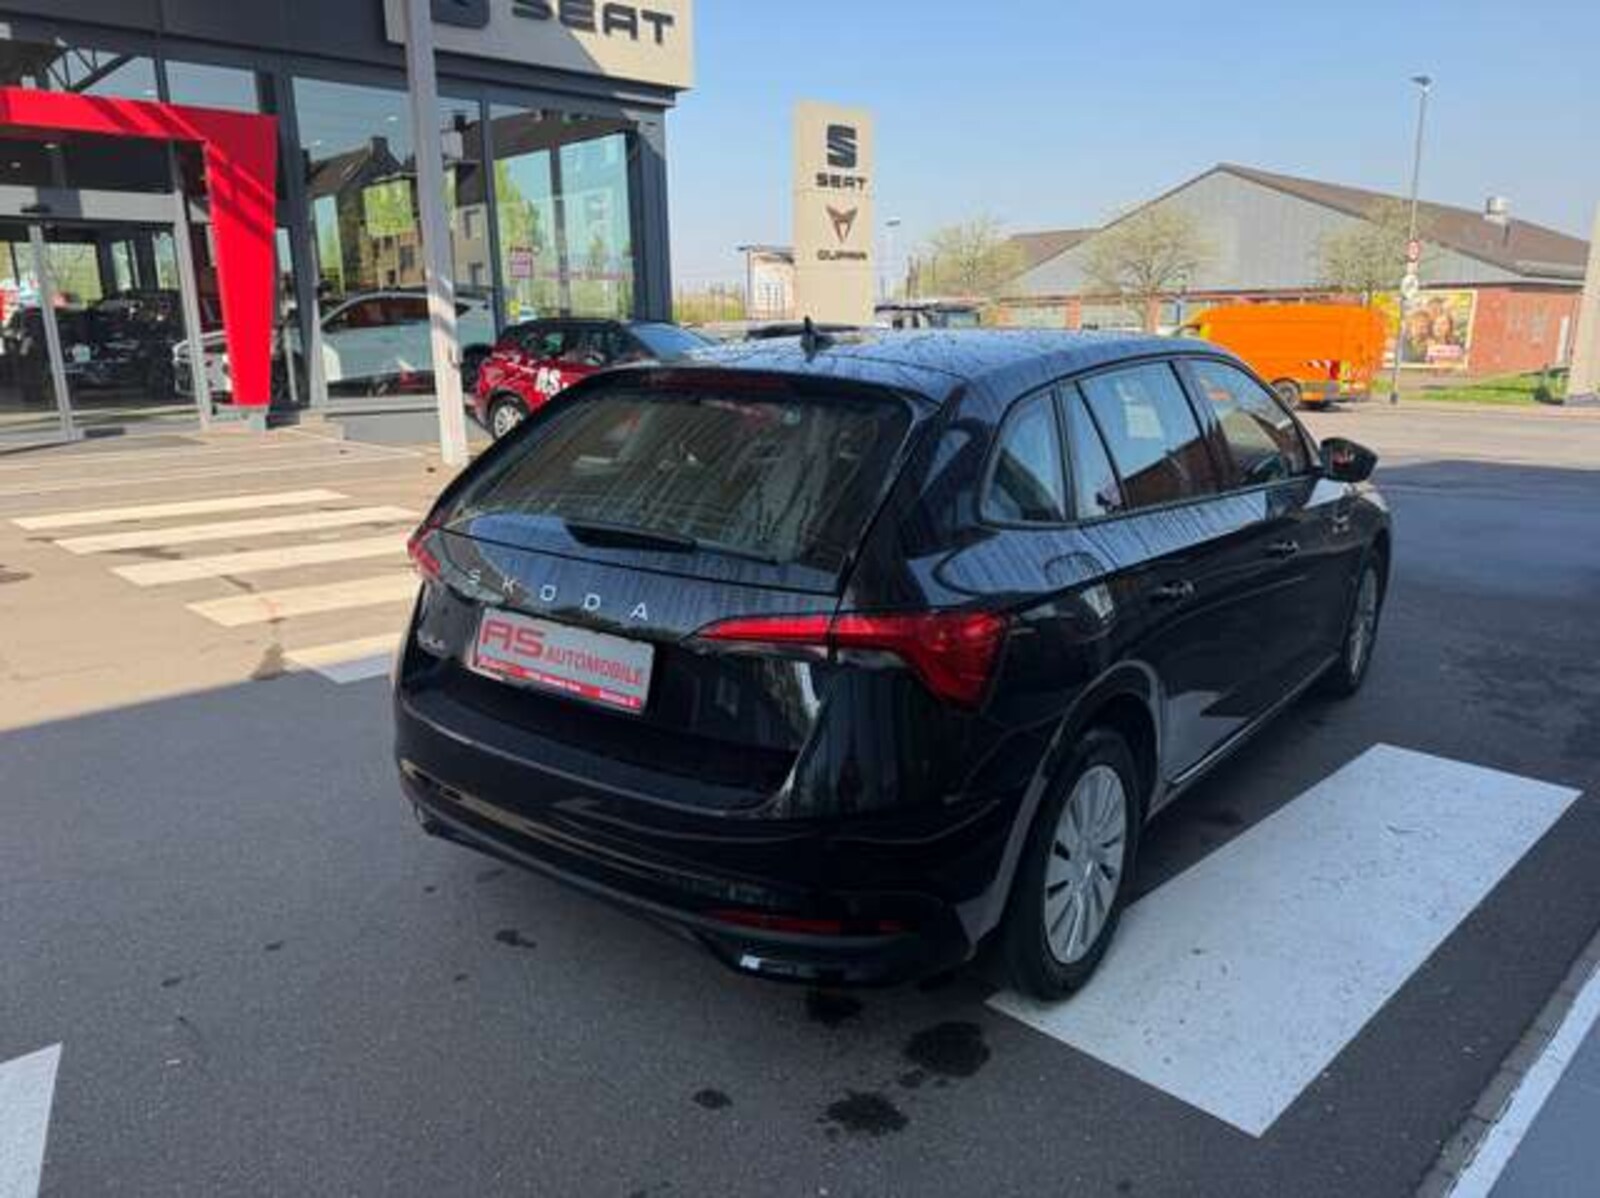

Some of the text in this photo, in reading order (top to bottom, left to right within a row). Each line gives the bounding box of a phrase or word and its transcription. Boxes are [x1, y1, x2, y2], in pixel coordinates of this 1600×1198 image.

[511, 0, 674, 46] SEAT
[816, 172, 868, 191] SEAT
[482, 619, 545, 658] AS
[543, 645, 642, 685] AUTOMOBILE
